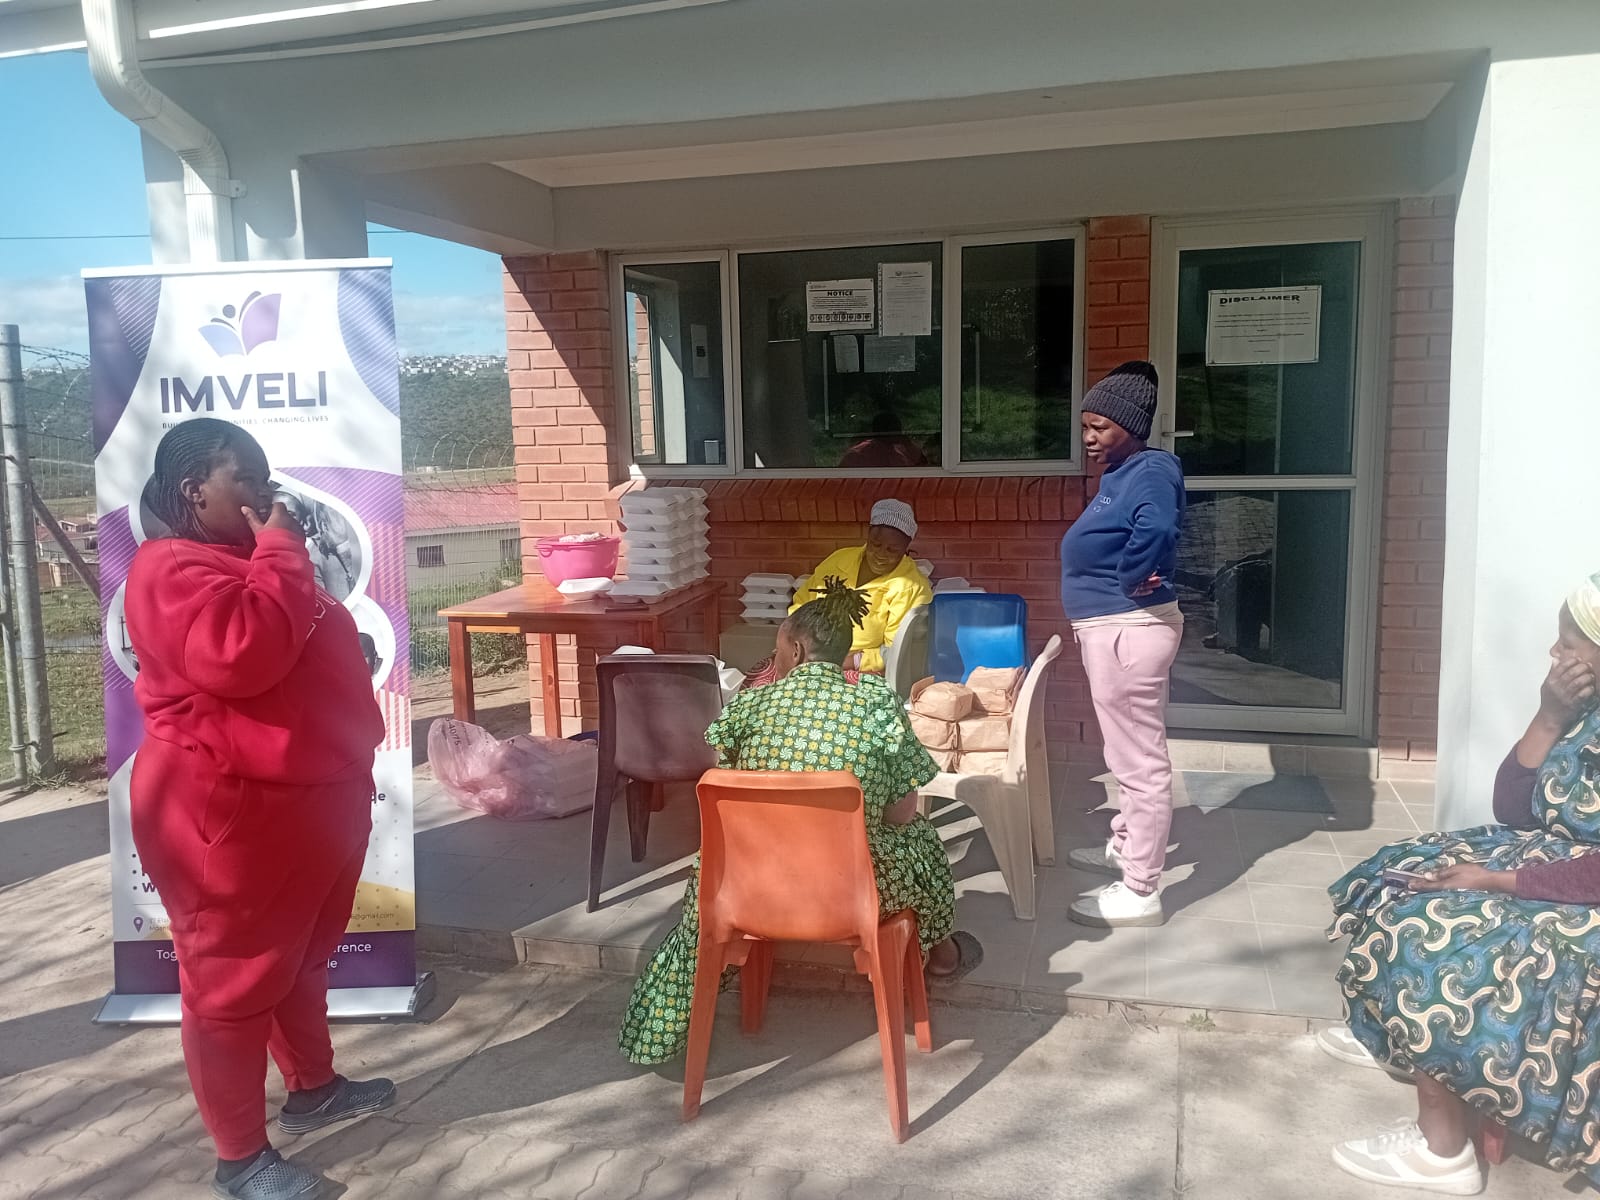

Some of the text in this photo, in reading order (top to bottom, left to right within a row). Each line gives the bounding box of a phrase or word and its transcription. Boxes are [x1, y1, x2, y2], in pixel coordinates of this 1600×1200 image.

[1219, 294, 1301, 305] DISCLAIMER
[160, 371, 328, 413] IMVELI
[262, 416, 305, 424] CHANGING
